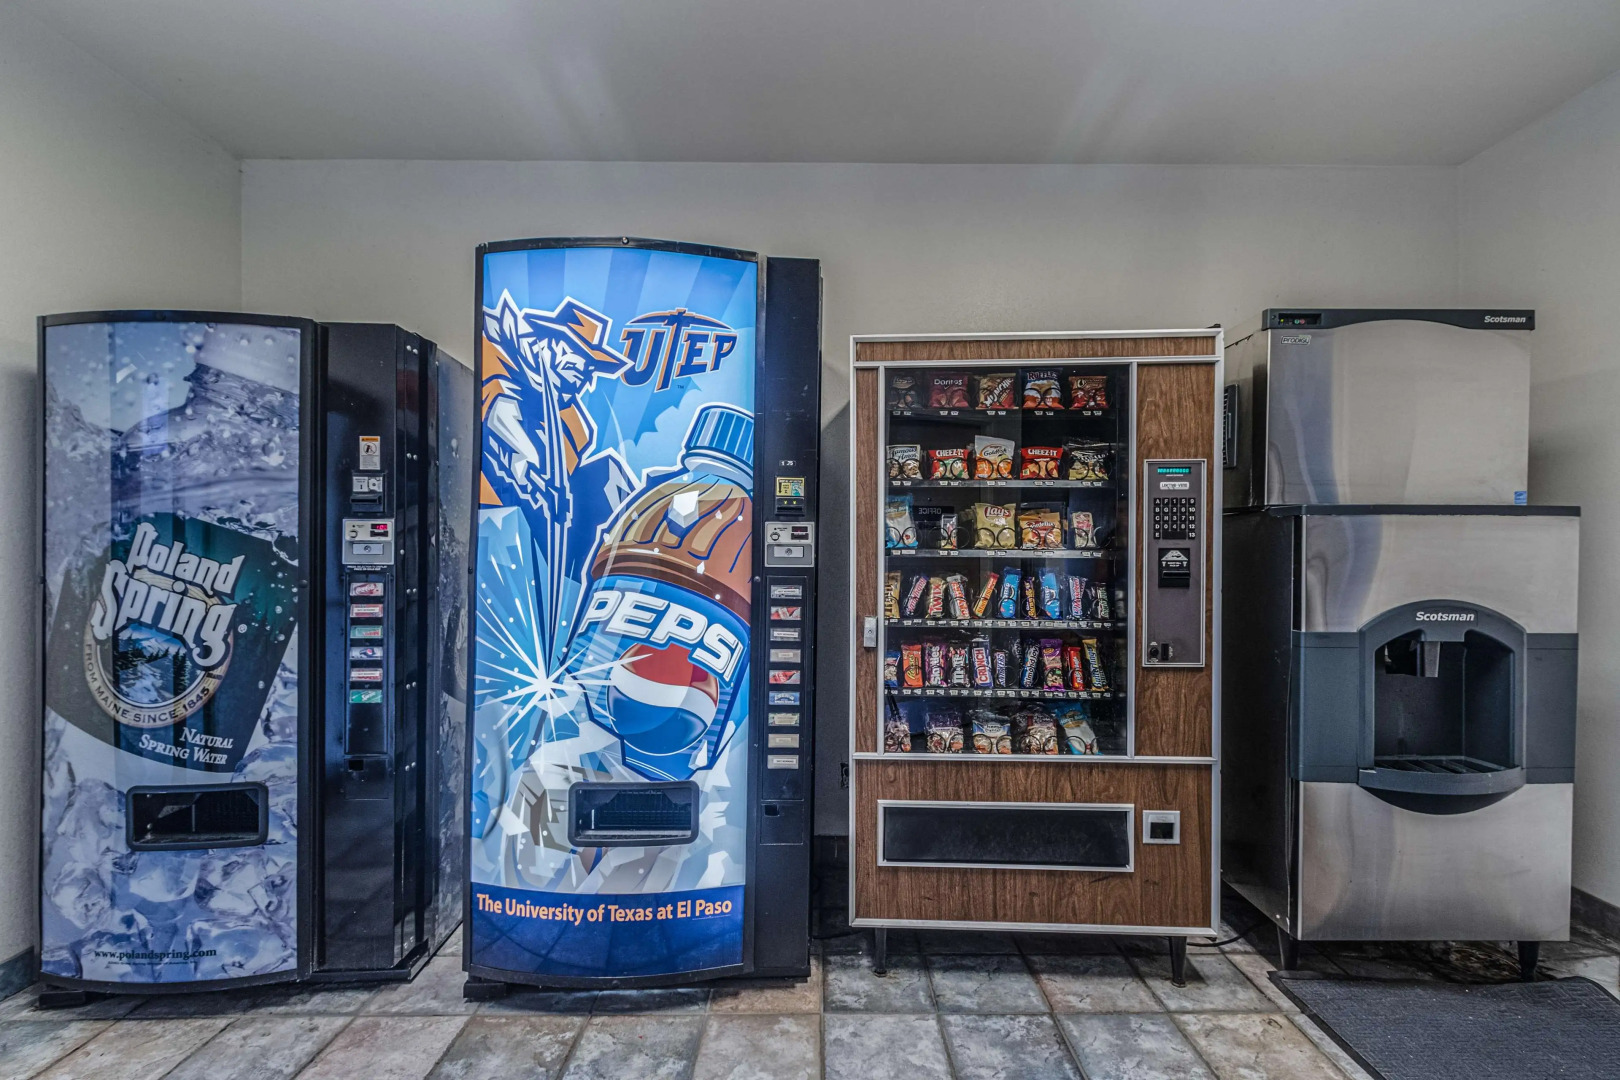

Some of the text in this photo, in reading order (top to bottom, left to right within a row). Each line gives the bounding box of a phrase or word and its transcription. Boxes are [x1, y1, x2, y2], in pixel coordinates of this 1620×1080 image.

[1484, 315, 1526, 324] Scotsman
[619, 312, 738, 392] UTEP
[934, 378, 963, 386] Doritos
[1027, 448, 1058, 456] CHEEZ-IT
[126, 522, 245, 596] Poland
[90, 560, 237, 667] Spring
[929, 583, 943, 615] TWIX
[1416, 611, 1475, 621] Scotsman
[579, 590, 743, 684] PEPSI
[974, 648, 989, 683] CRUNCH
[85, 643, 211, 724] FROM MAINE SINCE 1845
[139, 734, 228, 764] SPRING WATER
[179, 727, 234, 749] NATURAL
[476, 893, 732, 926] The University of Texas at El Paso
[94, 949, 217, 961] www.polandspring.com
